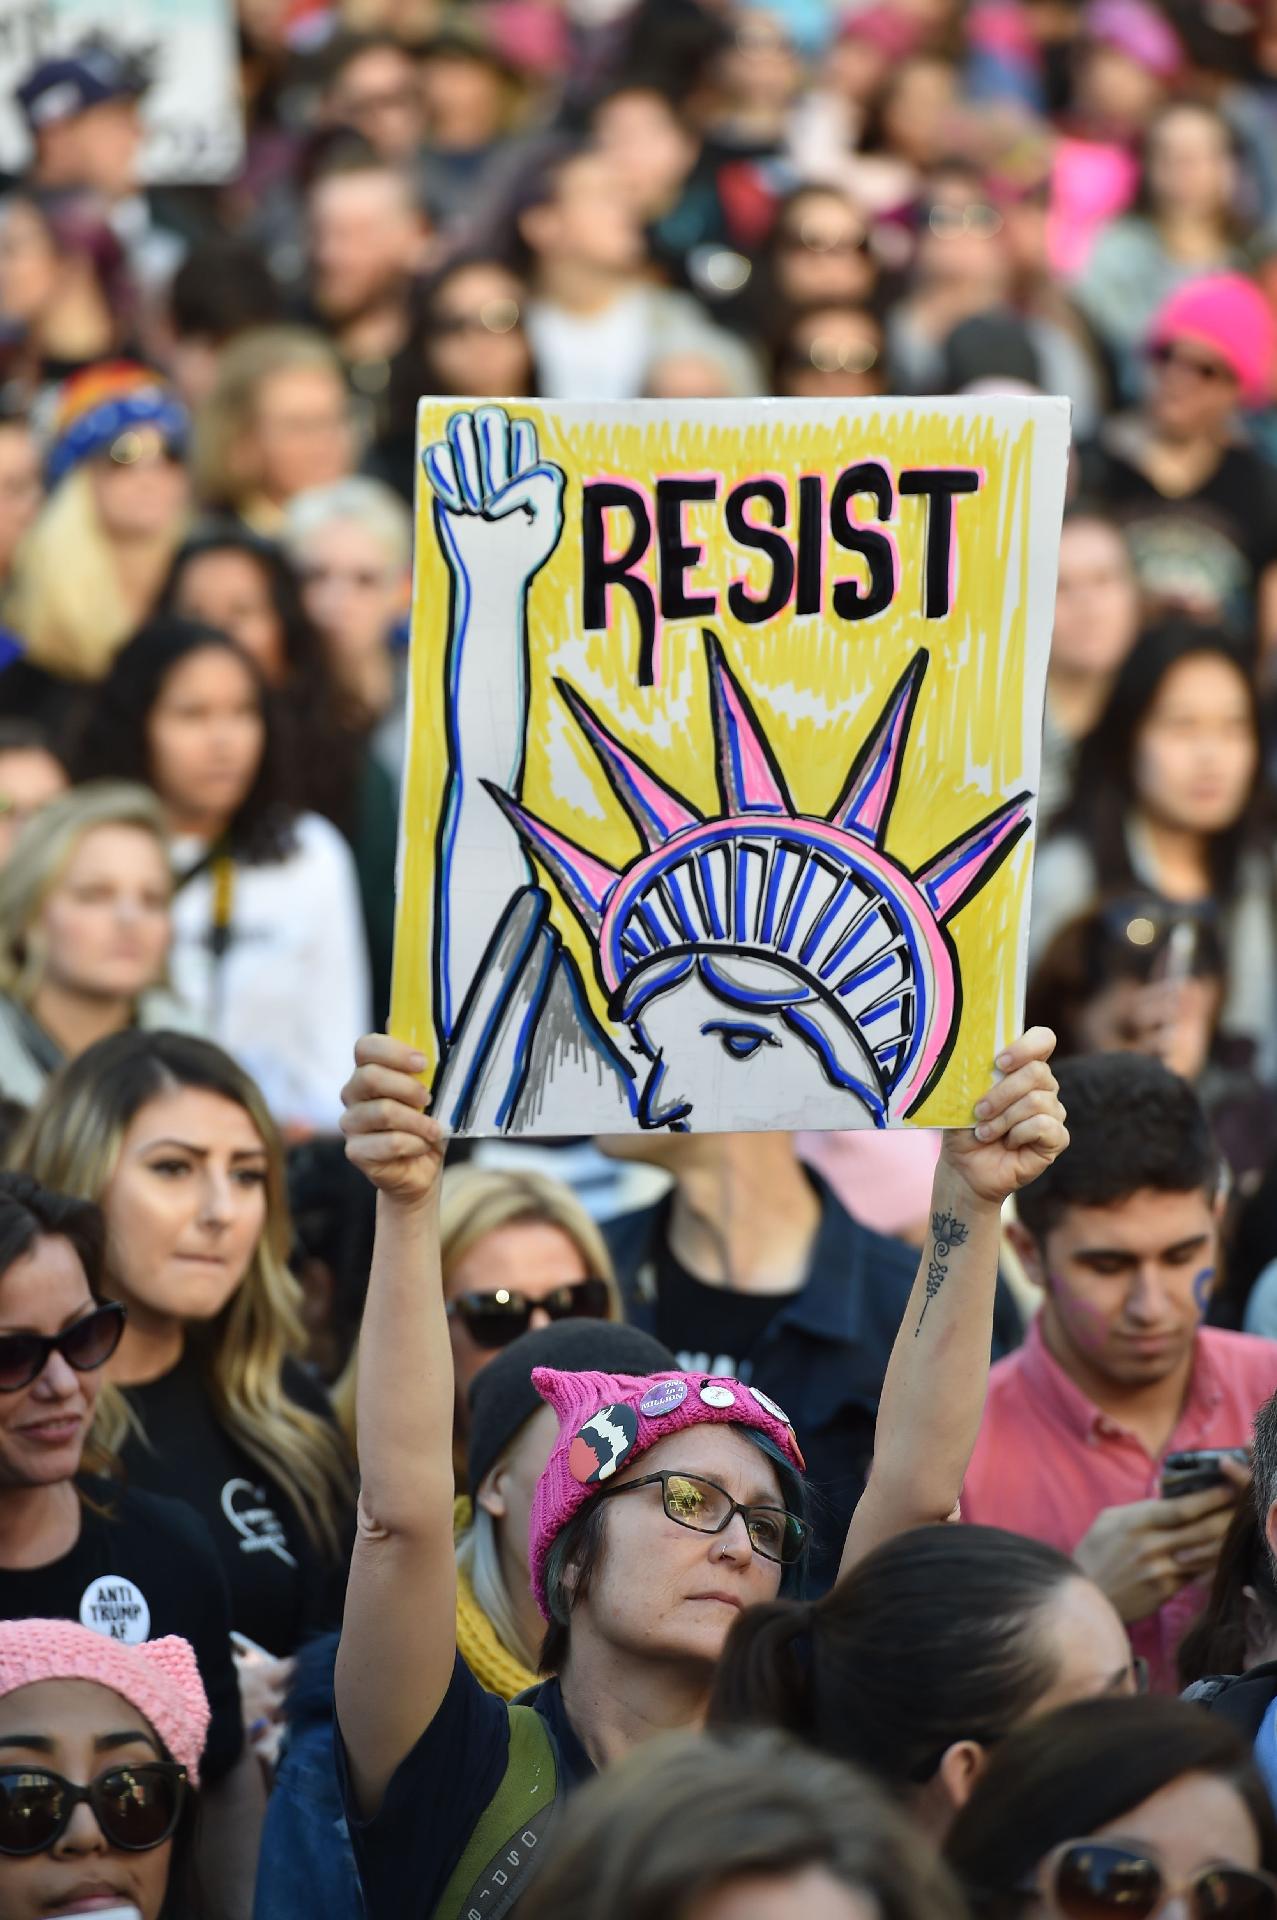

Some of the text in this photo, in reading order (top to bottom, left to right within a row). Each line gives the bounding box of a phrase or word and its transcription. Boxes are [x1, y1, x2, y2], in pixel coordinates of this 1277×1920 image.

[582, 462, 979, 687] RESIST
[97, 1586, 133, 1602] ANTI
[89, 1604, 142, 1622] TRUMP
